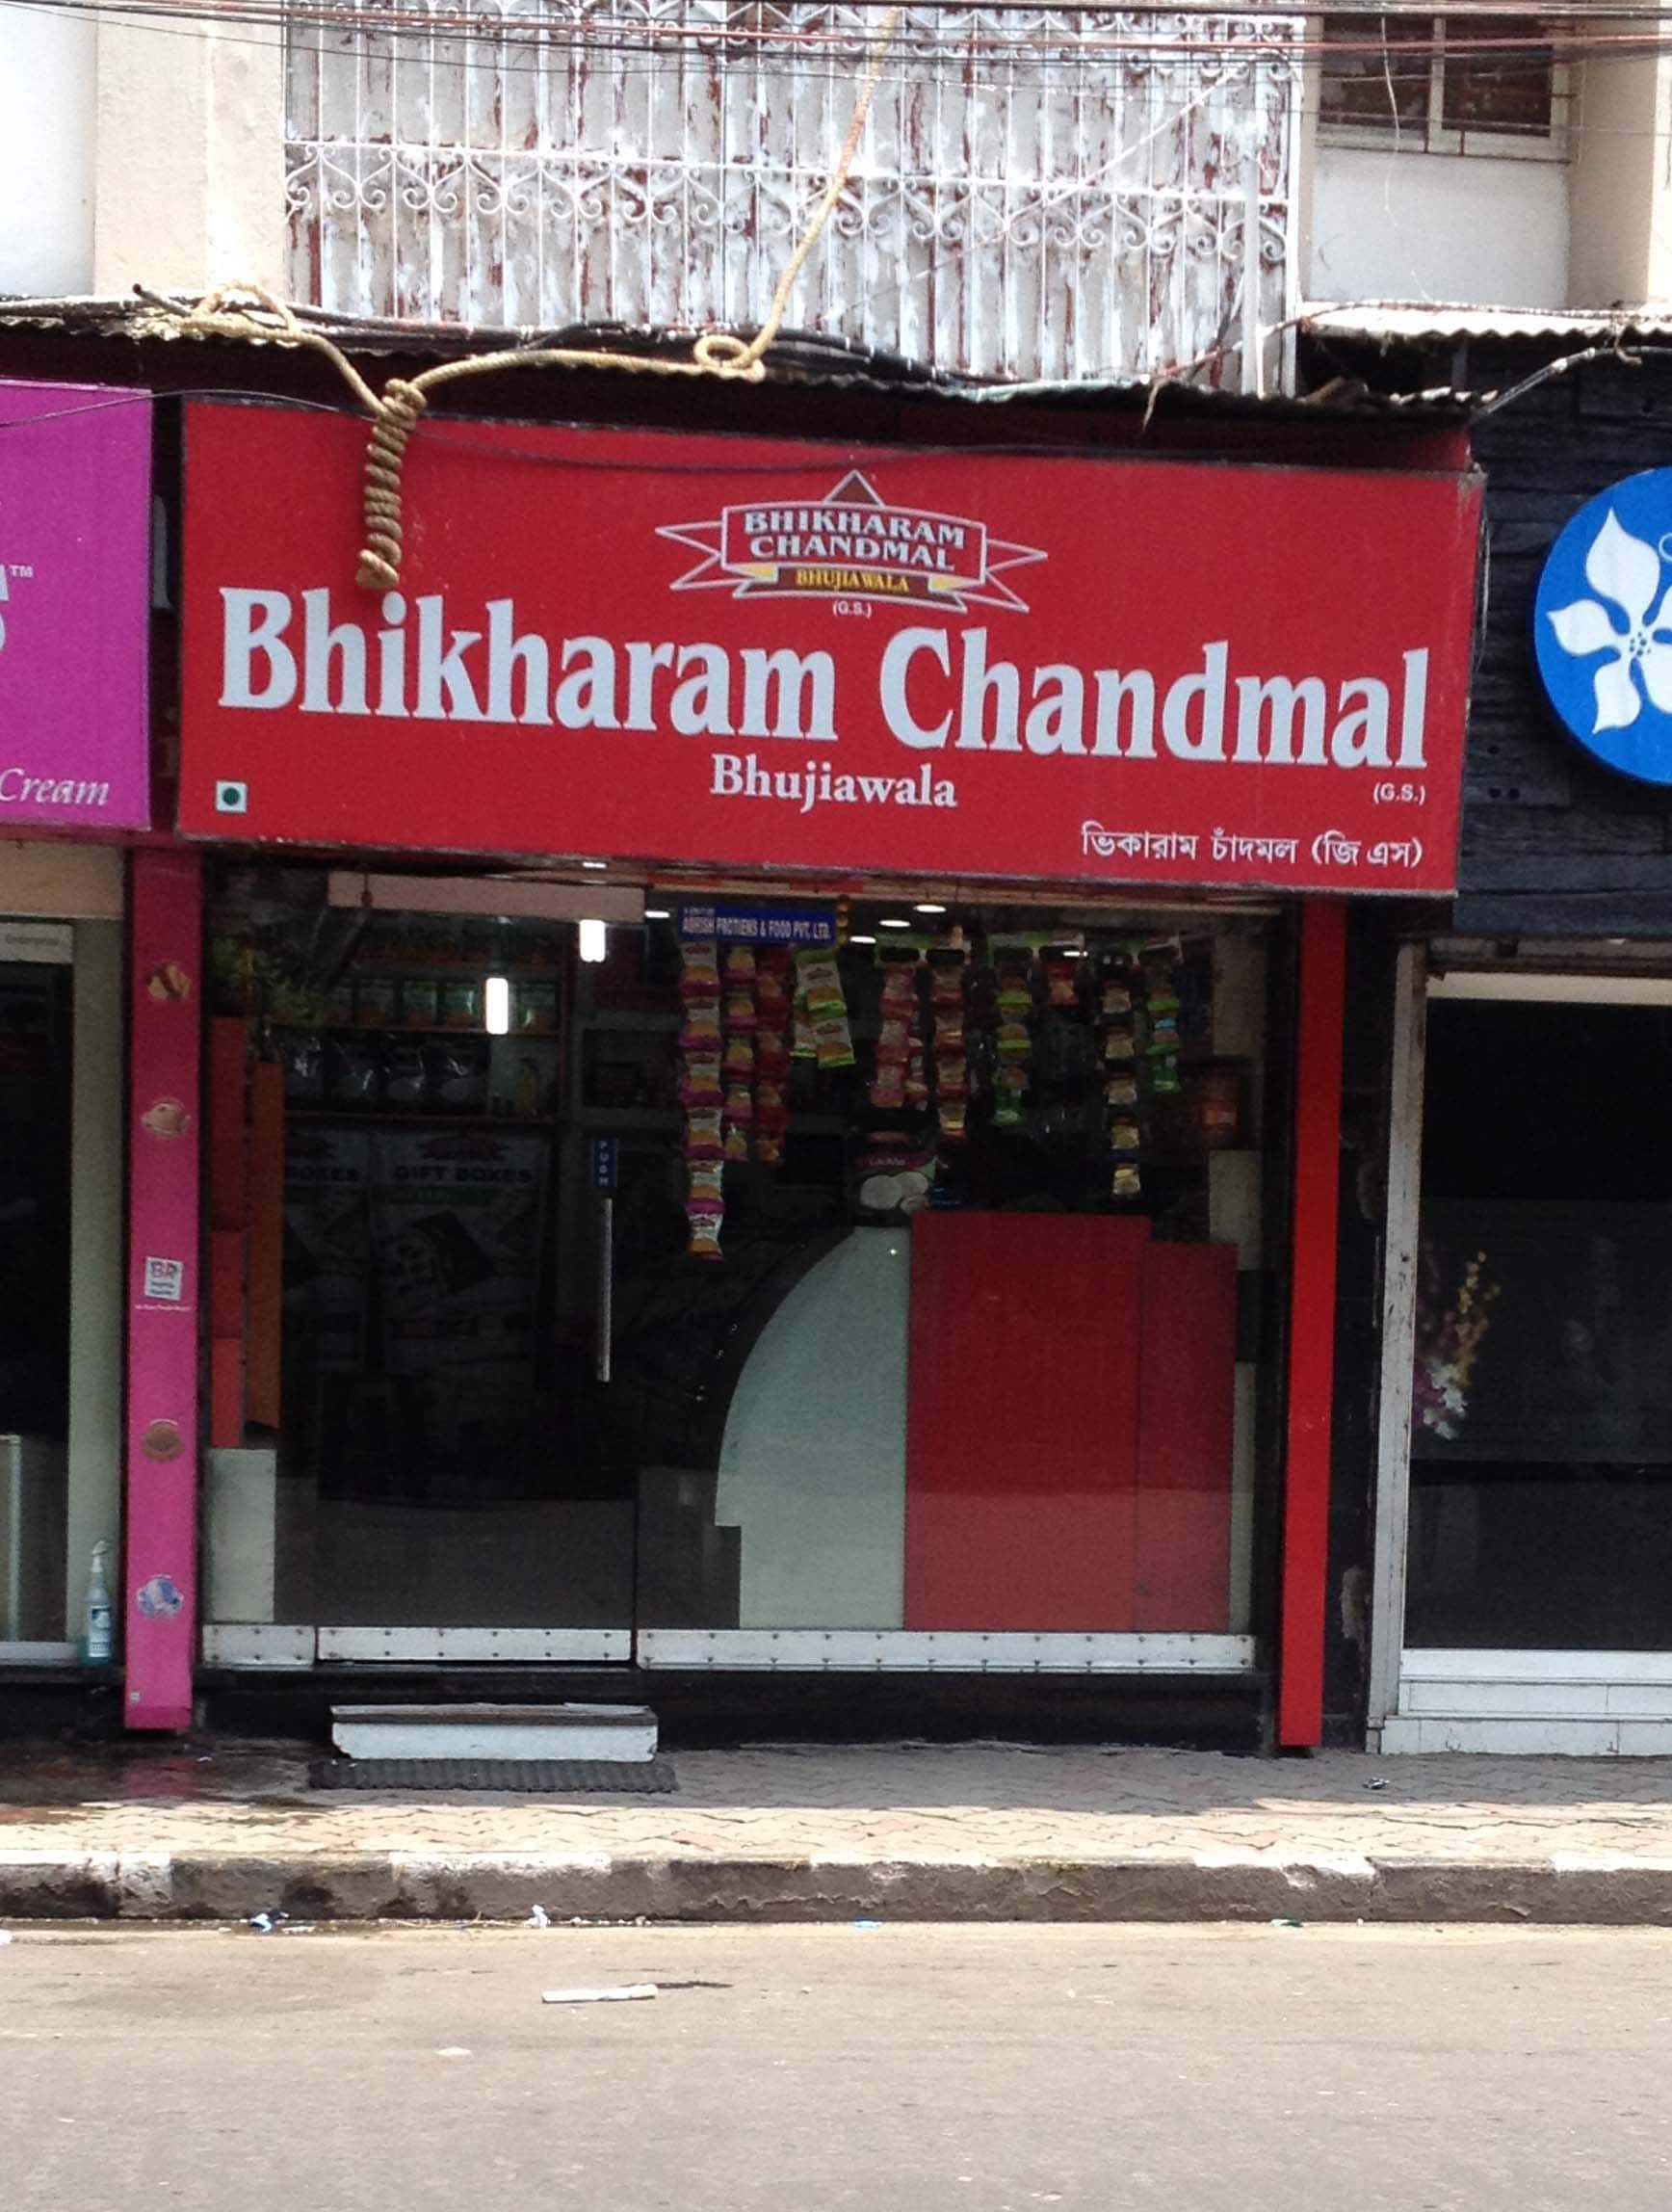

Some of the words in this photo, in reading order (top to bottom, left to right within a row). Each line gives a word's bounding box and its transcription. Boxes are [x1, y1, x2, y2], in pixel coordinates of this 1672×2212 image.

[744, 509, 966, 549] BHIKHARAM
[749, 535, 956, 571] CHANDMAL
[795, 568, 911, 593] BHUJIAWALA
[831, 599, 874, 619] (G.S.)
[218, 586, 841, 743] Bhikharam
[878, 625, 1429, 769] Chandmal
[0, 767, 110, 806] Cream
[709, 750, 959, 815] Bhujiawala
[1372, 782, 1427, 806] (G.S.)
